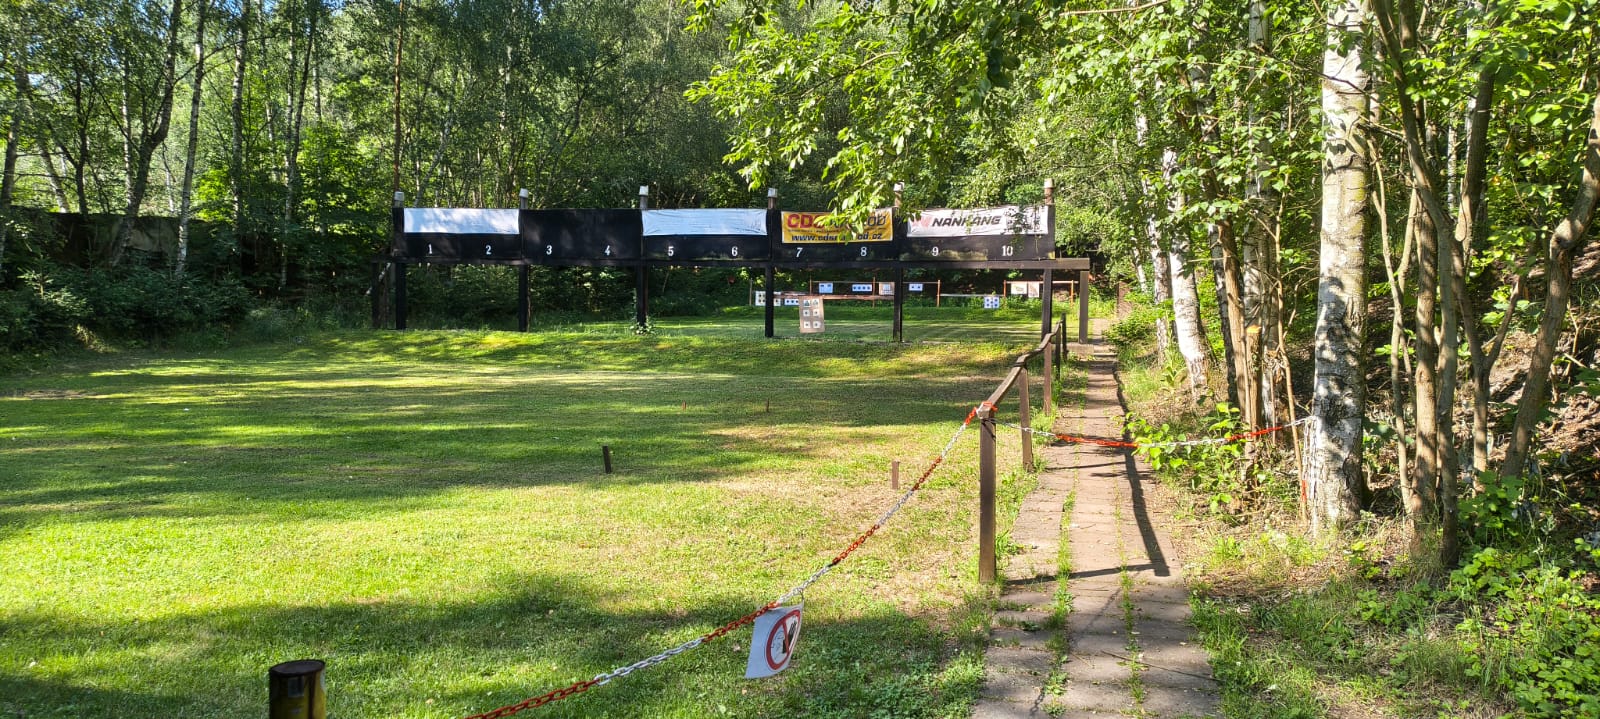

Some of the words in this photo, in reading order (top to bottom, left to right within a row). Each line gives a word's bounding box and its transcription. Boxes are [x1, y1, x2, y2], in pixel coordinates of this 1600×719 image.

[791, 232, 883, 241] www.cdsnod.cz
[428, 244, 433, 254] 1
[485, 245, 492, 255] 2
[546, 245, 553, 255] 3
[605, 245, 611, 256] 4
[667, 246, 675, 256] 5
[731, 246, 738, 256] 6
[795, 247, 803, 258] 7
[860, 246, 867, 257] 8
[931, 246, 939, 257] 9
[1001, 245, 1014, 257] 10
